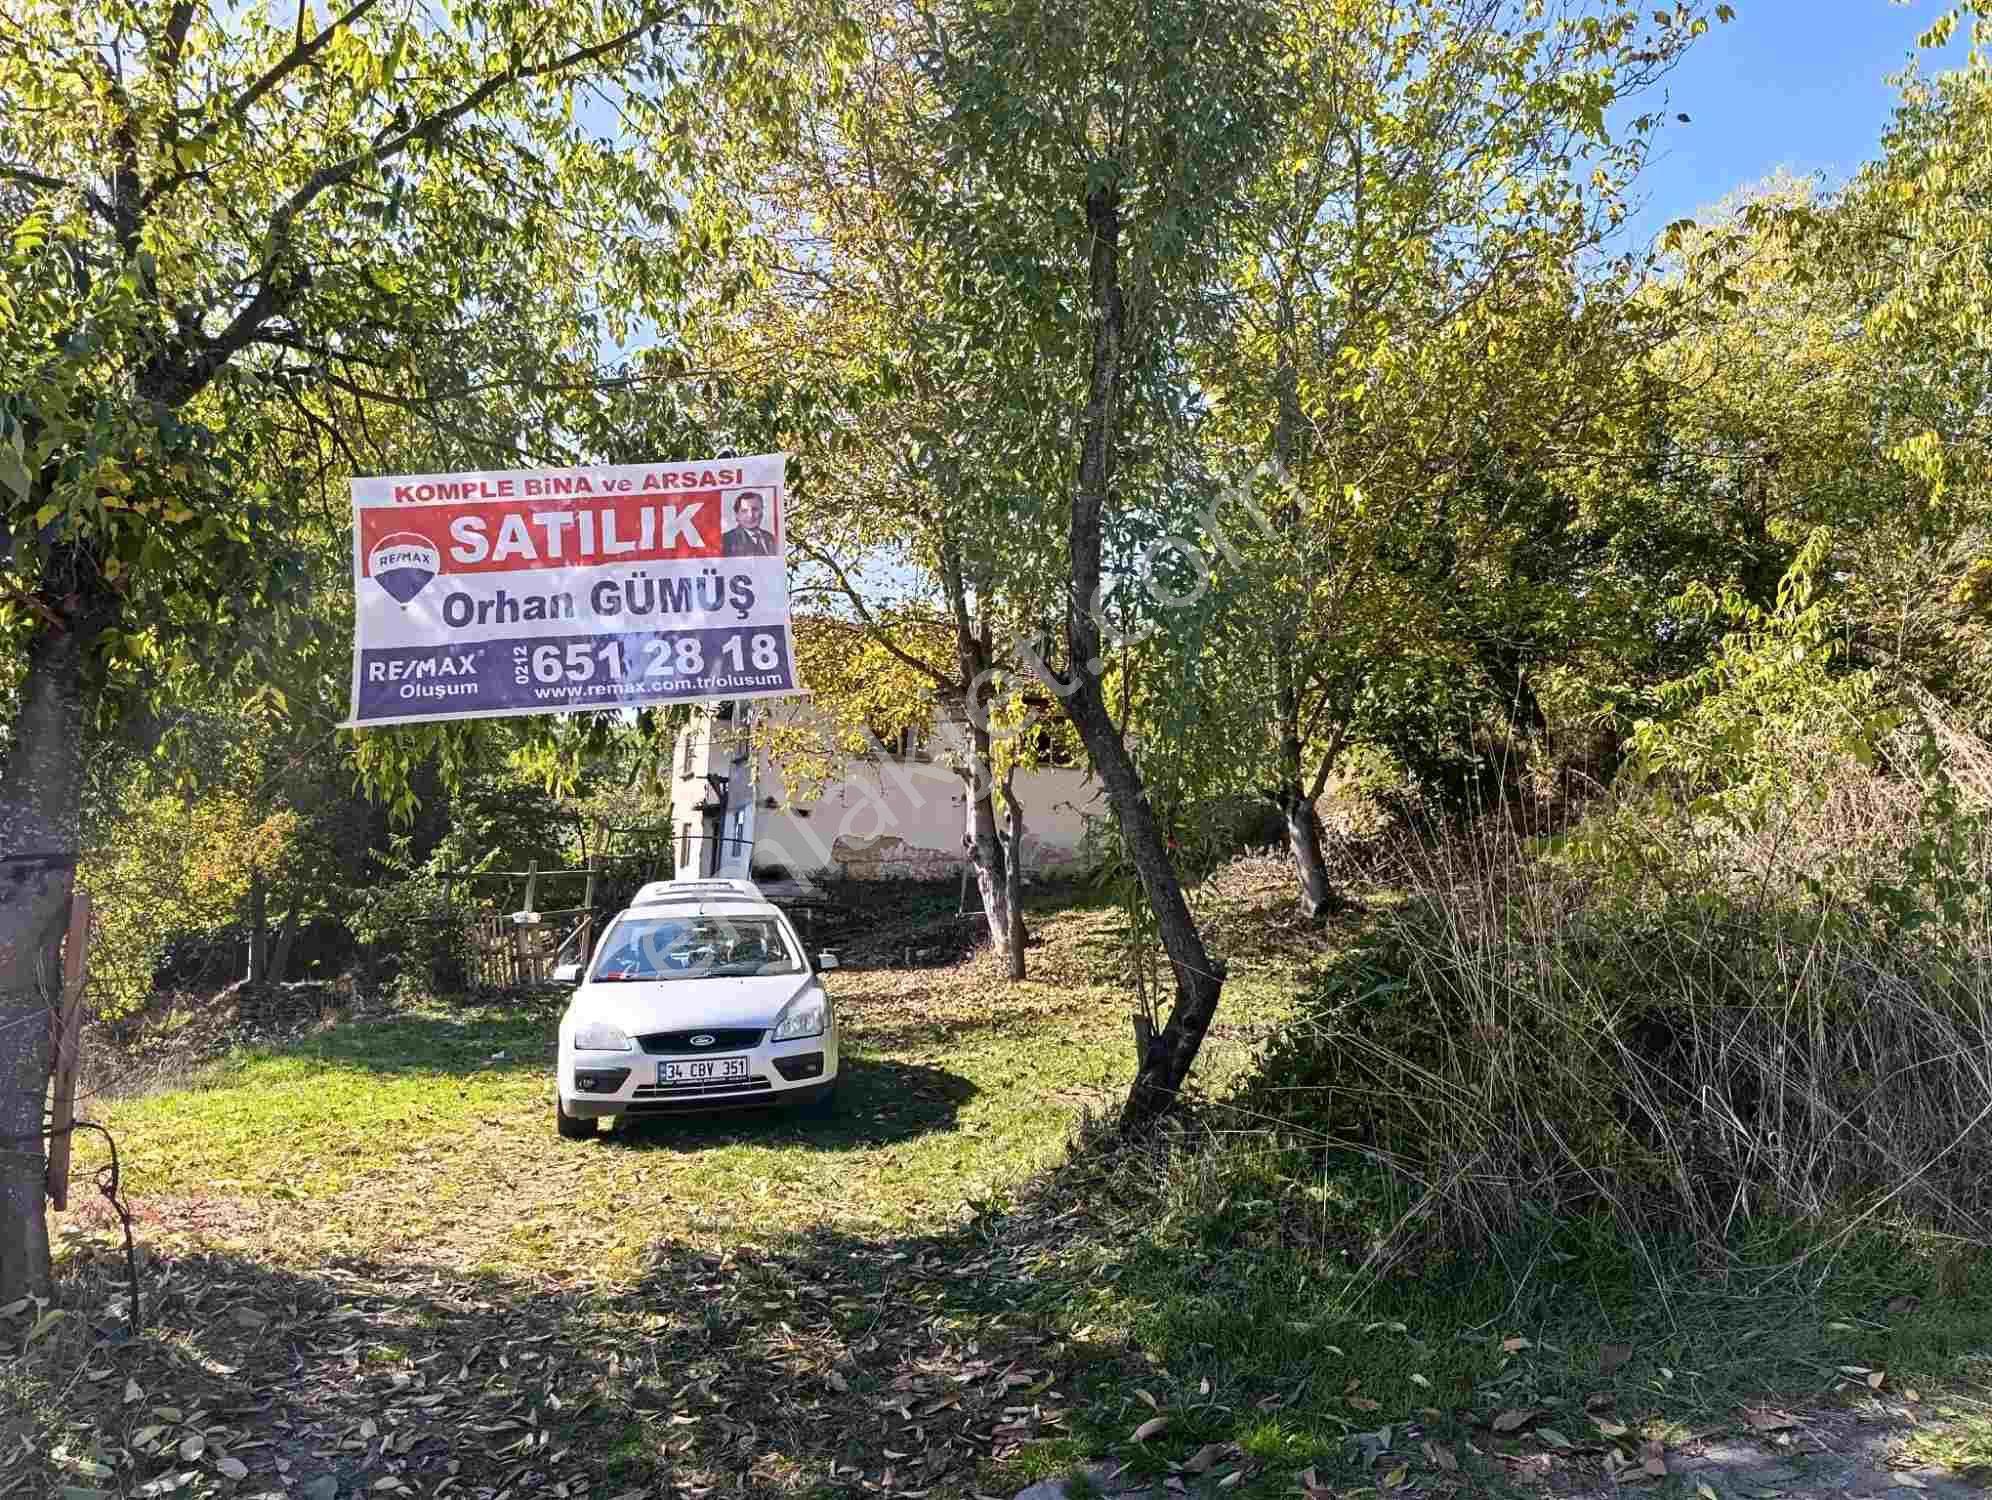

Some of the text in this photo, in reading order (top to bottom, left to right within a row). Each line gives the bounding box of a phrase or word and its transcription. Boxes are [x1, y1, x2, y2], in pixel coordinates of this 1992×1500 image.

[394, 468, 743, 503] KOMPLE BiNA ve ARSASI
[449, 501, 706, 564] SATILIK
[378, 550, 431, 567] RE/MAX
[442, 568, 756, 628] Orhan GÜMÜŞ
[369, 653, 477, 682] RE/MAX
[513, 644, 529, 684] 0212
[532, 633, 780, 683] 651 28 18
[400, 681, 479, 699] Oluşum
[534, 673, 784, 699] www.remax.com.tr/olusum
[666, 1060, 745, 1079] 34 CBV 351
